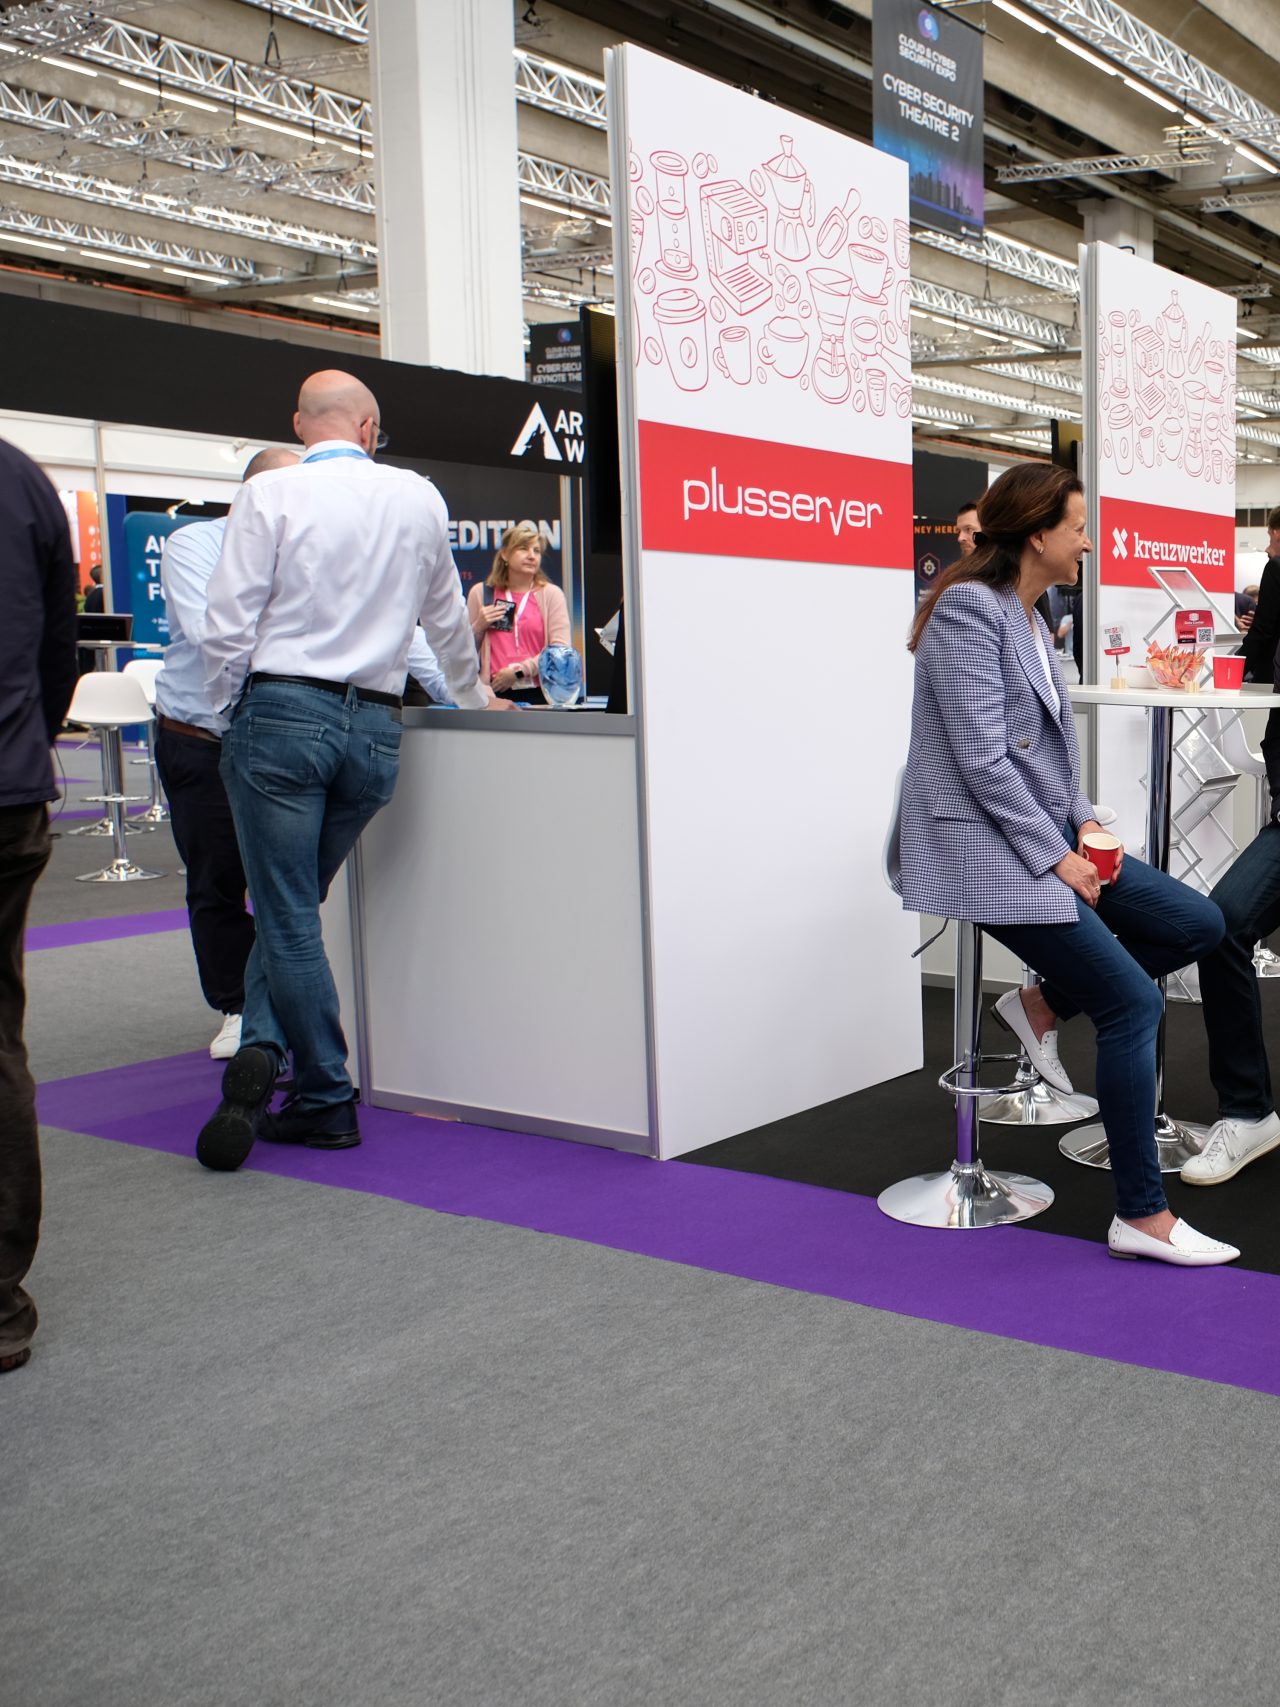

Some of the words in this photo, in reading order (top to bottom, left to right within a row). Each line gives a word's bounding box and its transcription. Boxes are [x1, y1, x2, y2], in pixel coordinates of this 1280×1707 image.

[898, 33, 926, 56] CLOUD
[931, 49, 957, 72] CYBER
[898, 45, 936, 72] SECURITY
[935, 64, 957, 82] EXPO
[882, 73, 922, 104] CYBER
[923, 91, 974, 129] SECURITY
[899, 100, 949, 138] THEATRE
[951, 126, 960, 142] 2
[683, 466, 883, 537] plusserver
[1133, 532, 1226, 567] kreuzwerker
